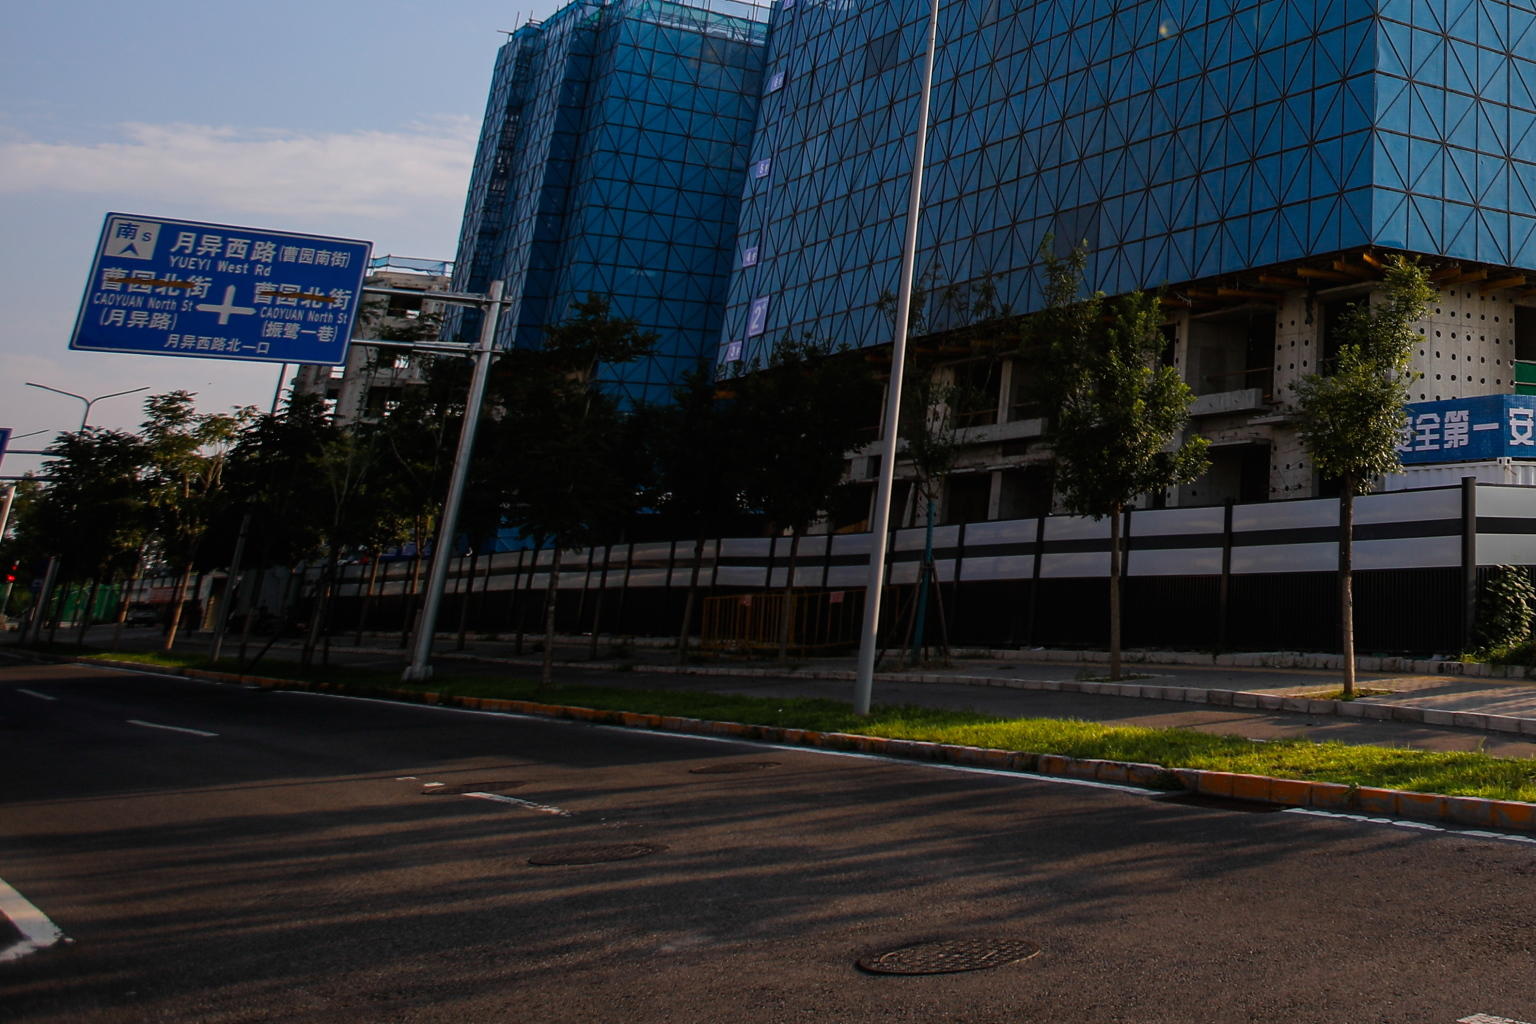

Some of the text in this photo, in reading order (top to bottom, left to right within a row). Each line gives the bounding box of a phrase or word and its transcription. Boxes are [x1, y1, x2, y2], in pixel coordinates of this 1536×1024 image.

[116, 222, 152, 242] 南 S
[170, 232, 277, 264] 月异西路
[169, 255, 272, 277] YUEYI West Rd
[101, 267, 213, 299] 曹园北街
[93, 292, 194, 312] CAOYUAN North St
[253, 282, 352, 311] 曹园北街
[260, 306, 347, 325] CAOYUAN North St
[163, 334, 270, 355] 月异西路北一口
